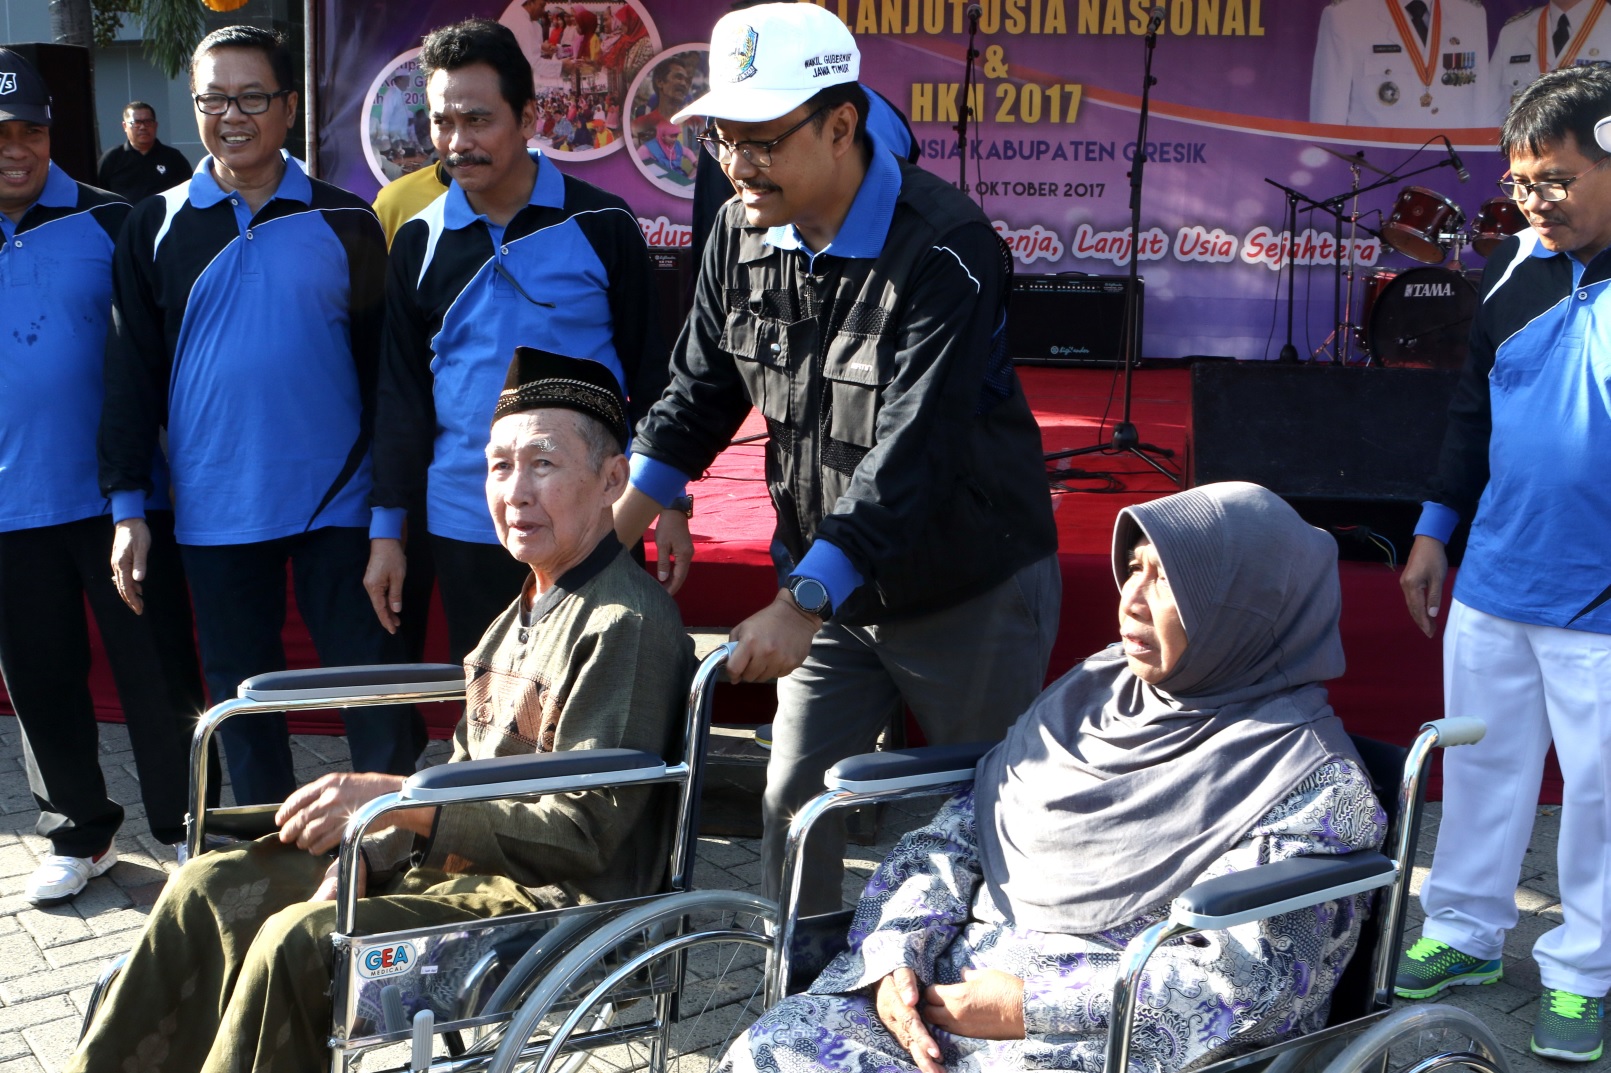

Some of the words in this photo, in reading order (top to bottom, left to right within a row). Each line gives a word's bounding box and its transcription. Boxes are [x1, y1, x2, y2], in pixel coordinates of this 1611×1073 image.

[837, 0, 968, 35] LANJUT
[979, 0, 1066, 35] USIA
[813, 66, 830, 78] JAWA
[831, 63, 849, 74] TIMUR
[984, 45, 1008, 79] &
[995, 83, 1082, 124] 2017
[970, 140, 1115, 162] KABUPATEN
[1122, 141, 1207, 164] GRESIK
[975, 181, 1059, 197] OKTOBER
[1063, 183, 1106, 198] 2017
[1077, 229, 1163, 260] Lanjut
[1179, 231, 1232, 257] Usia
[1246, 232, 1375, 265] Sejahtera
[1413, 283, 1451, 297] TAMA
[365, 945, 408, 971] GEA
[370, 966, 403, 976] MEDICAL
